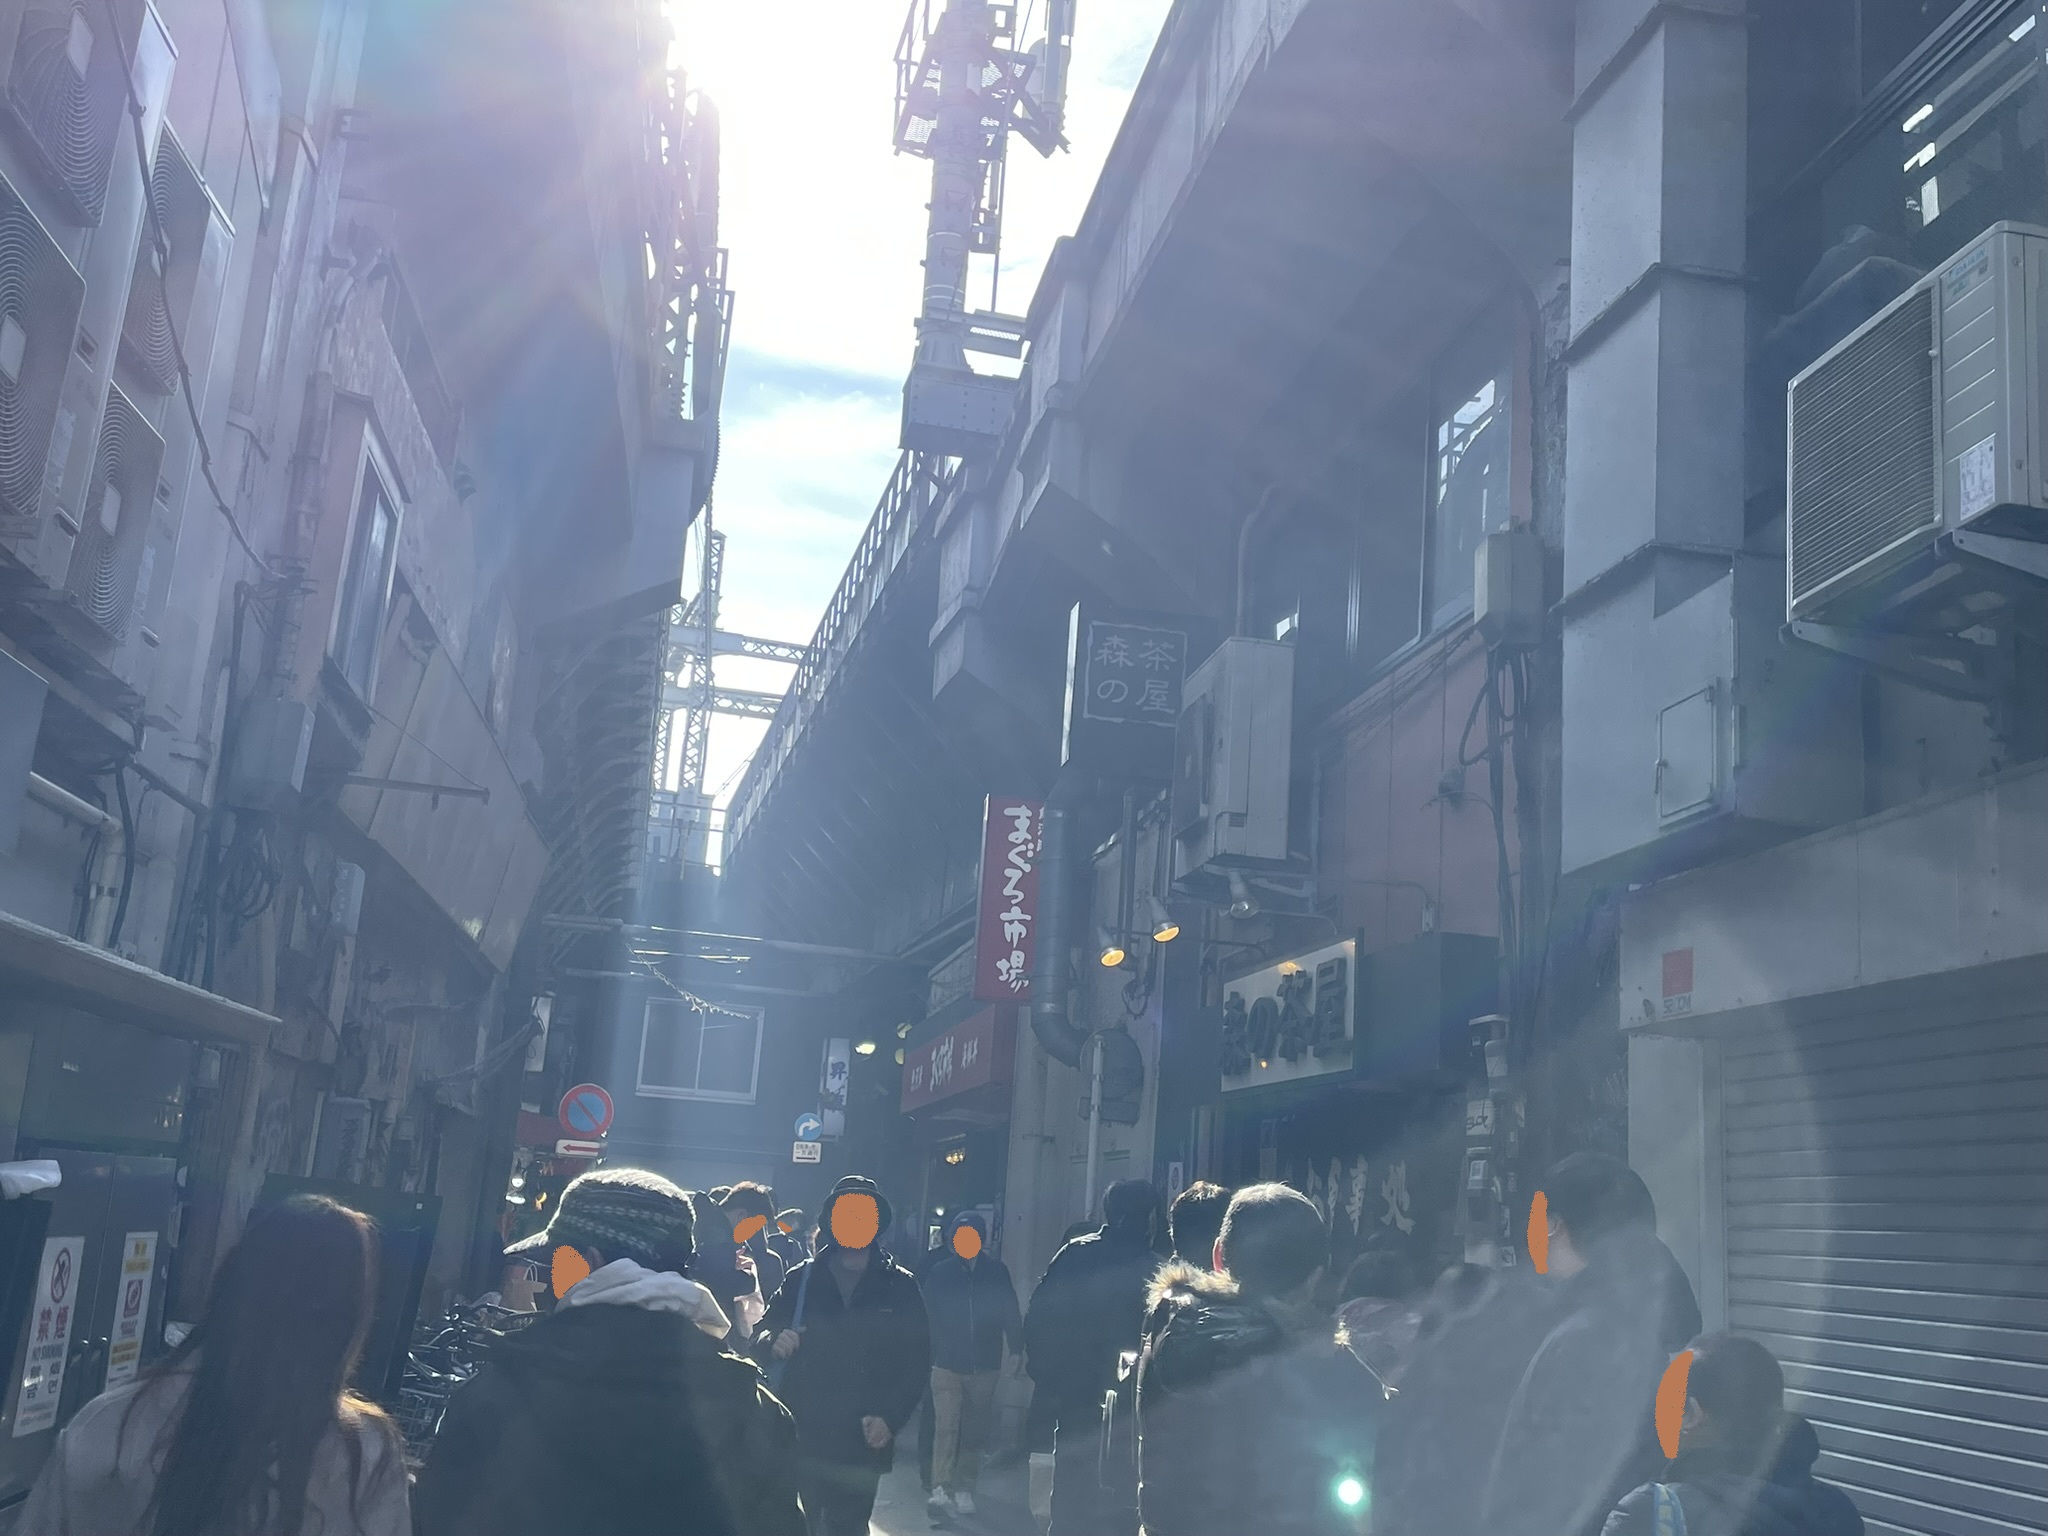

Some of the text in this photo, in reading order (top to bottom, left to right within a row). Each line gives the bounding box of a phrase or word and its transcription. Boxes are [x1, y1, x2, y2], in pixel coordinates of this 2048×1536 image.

[1094, 634, 1135, 704] 森の
[1136, 639, 1178, 714] 茶屋
[995, 803, 1034, 995] まぐろ市場
[1222, 957, 1352, 1076] 森の茶屋
[36, 1305, 69, 1342] 禁煙
